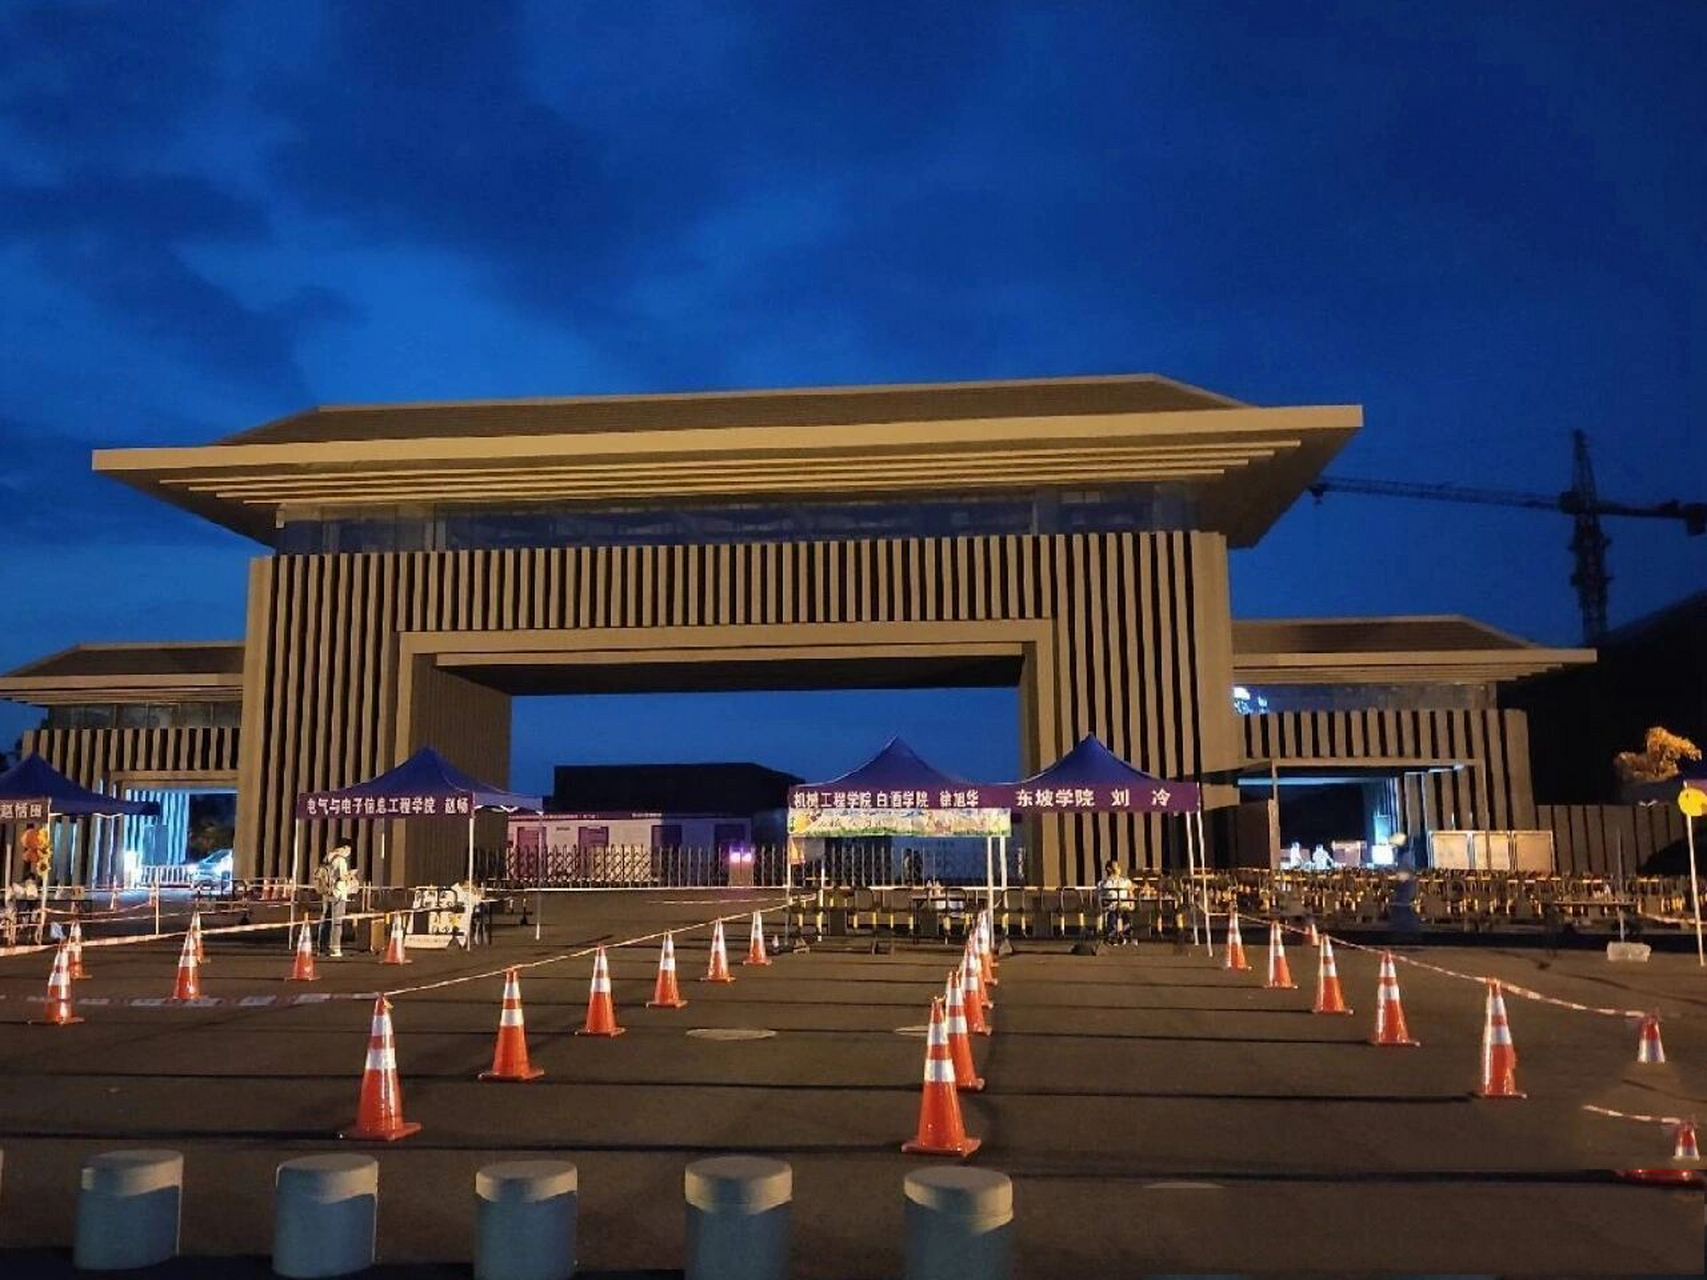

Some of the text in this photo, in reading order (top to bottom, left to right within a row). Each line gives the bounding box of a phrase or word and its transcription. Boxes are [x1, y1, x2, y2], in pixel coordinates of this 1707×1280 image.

[307, 797, 436, 814] 电气与电子信息工程学院
[793, 789, 979, 808] 机械工程学院 白酒学院 徐旭华
[1015, 789, 1095, 807] 东坡学院
[1111, 789, 1130, 807] 刘
